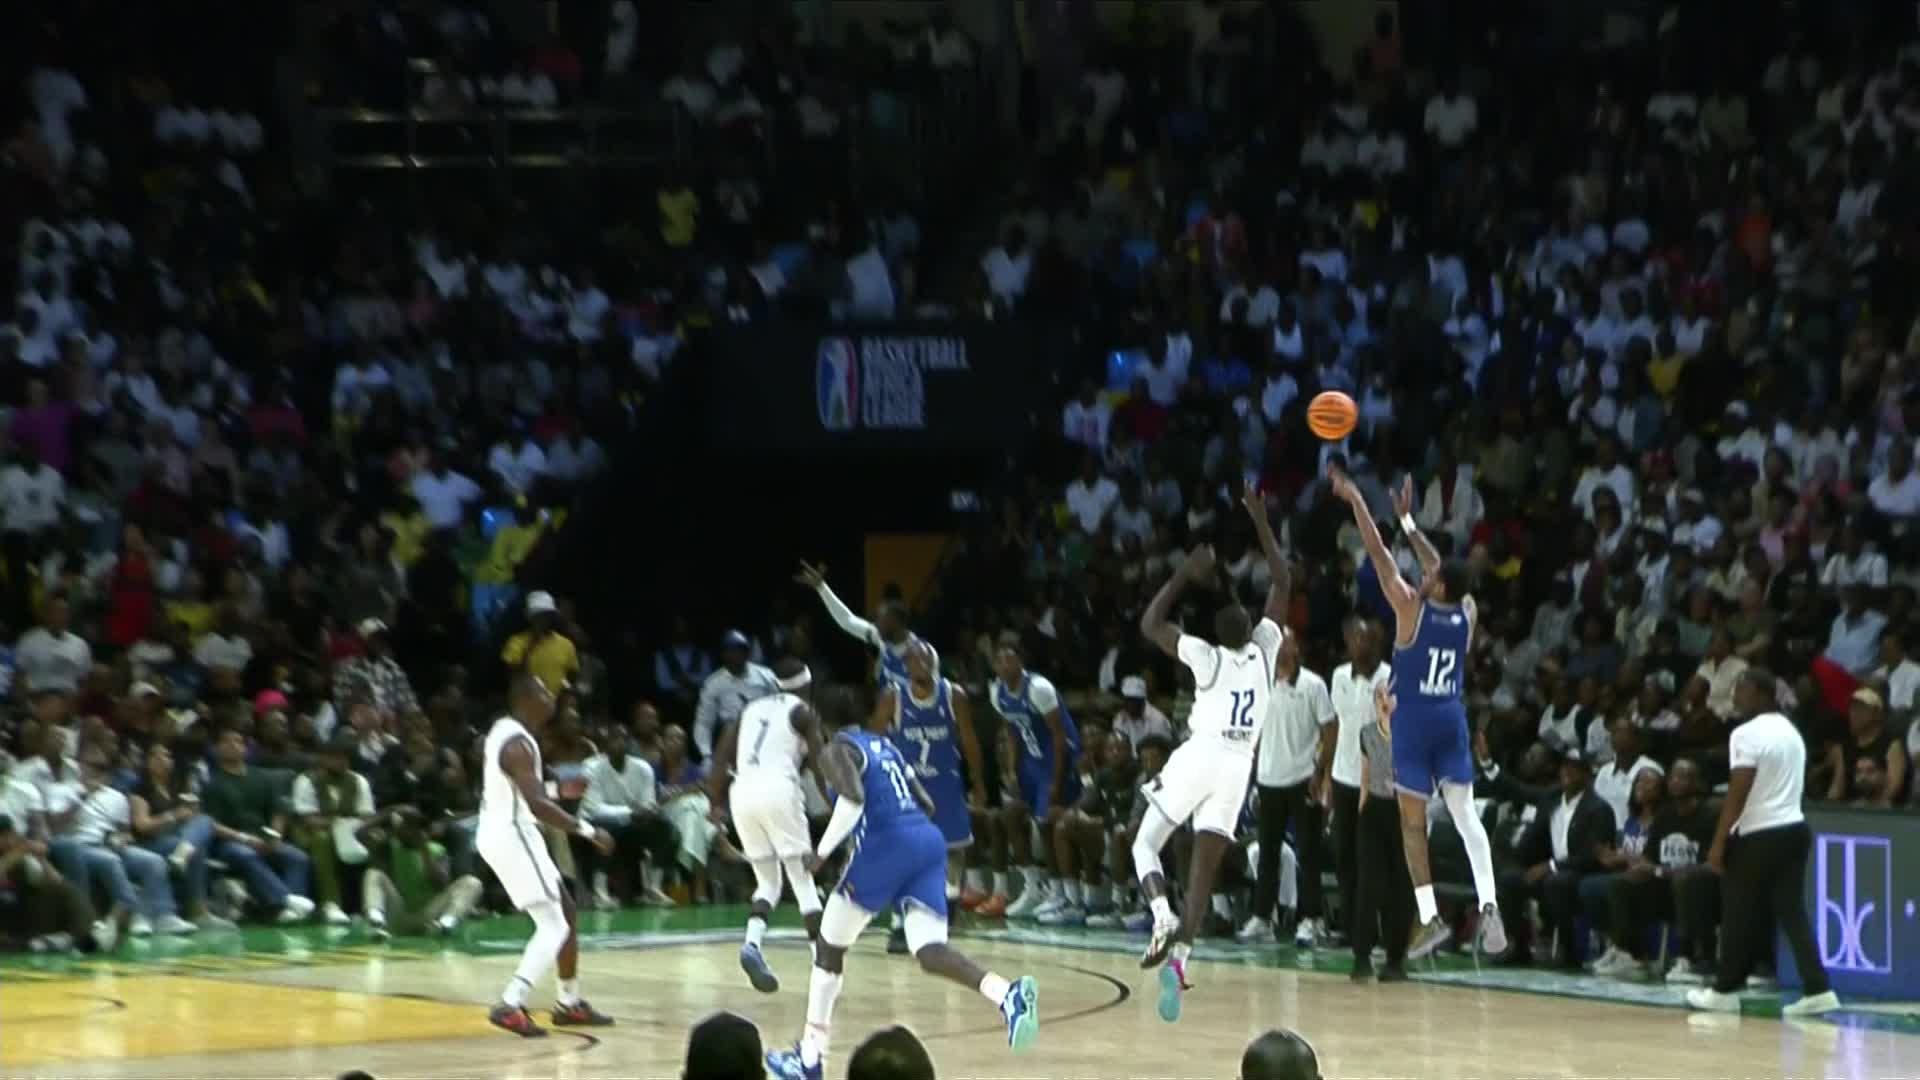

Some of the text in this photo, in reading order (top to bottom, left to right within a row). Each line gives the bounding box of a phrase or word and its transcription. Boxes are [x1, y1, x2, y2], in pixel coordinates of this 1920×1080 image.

[862, 336, 969, 369] BASKETBALL
[863, 397, 926, 428] LEAGUE
[1428, 647, 1456, 690] 12
[1230, 688, 1255, 727] 12
